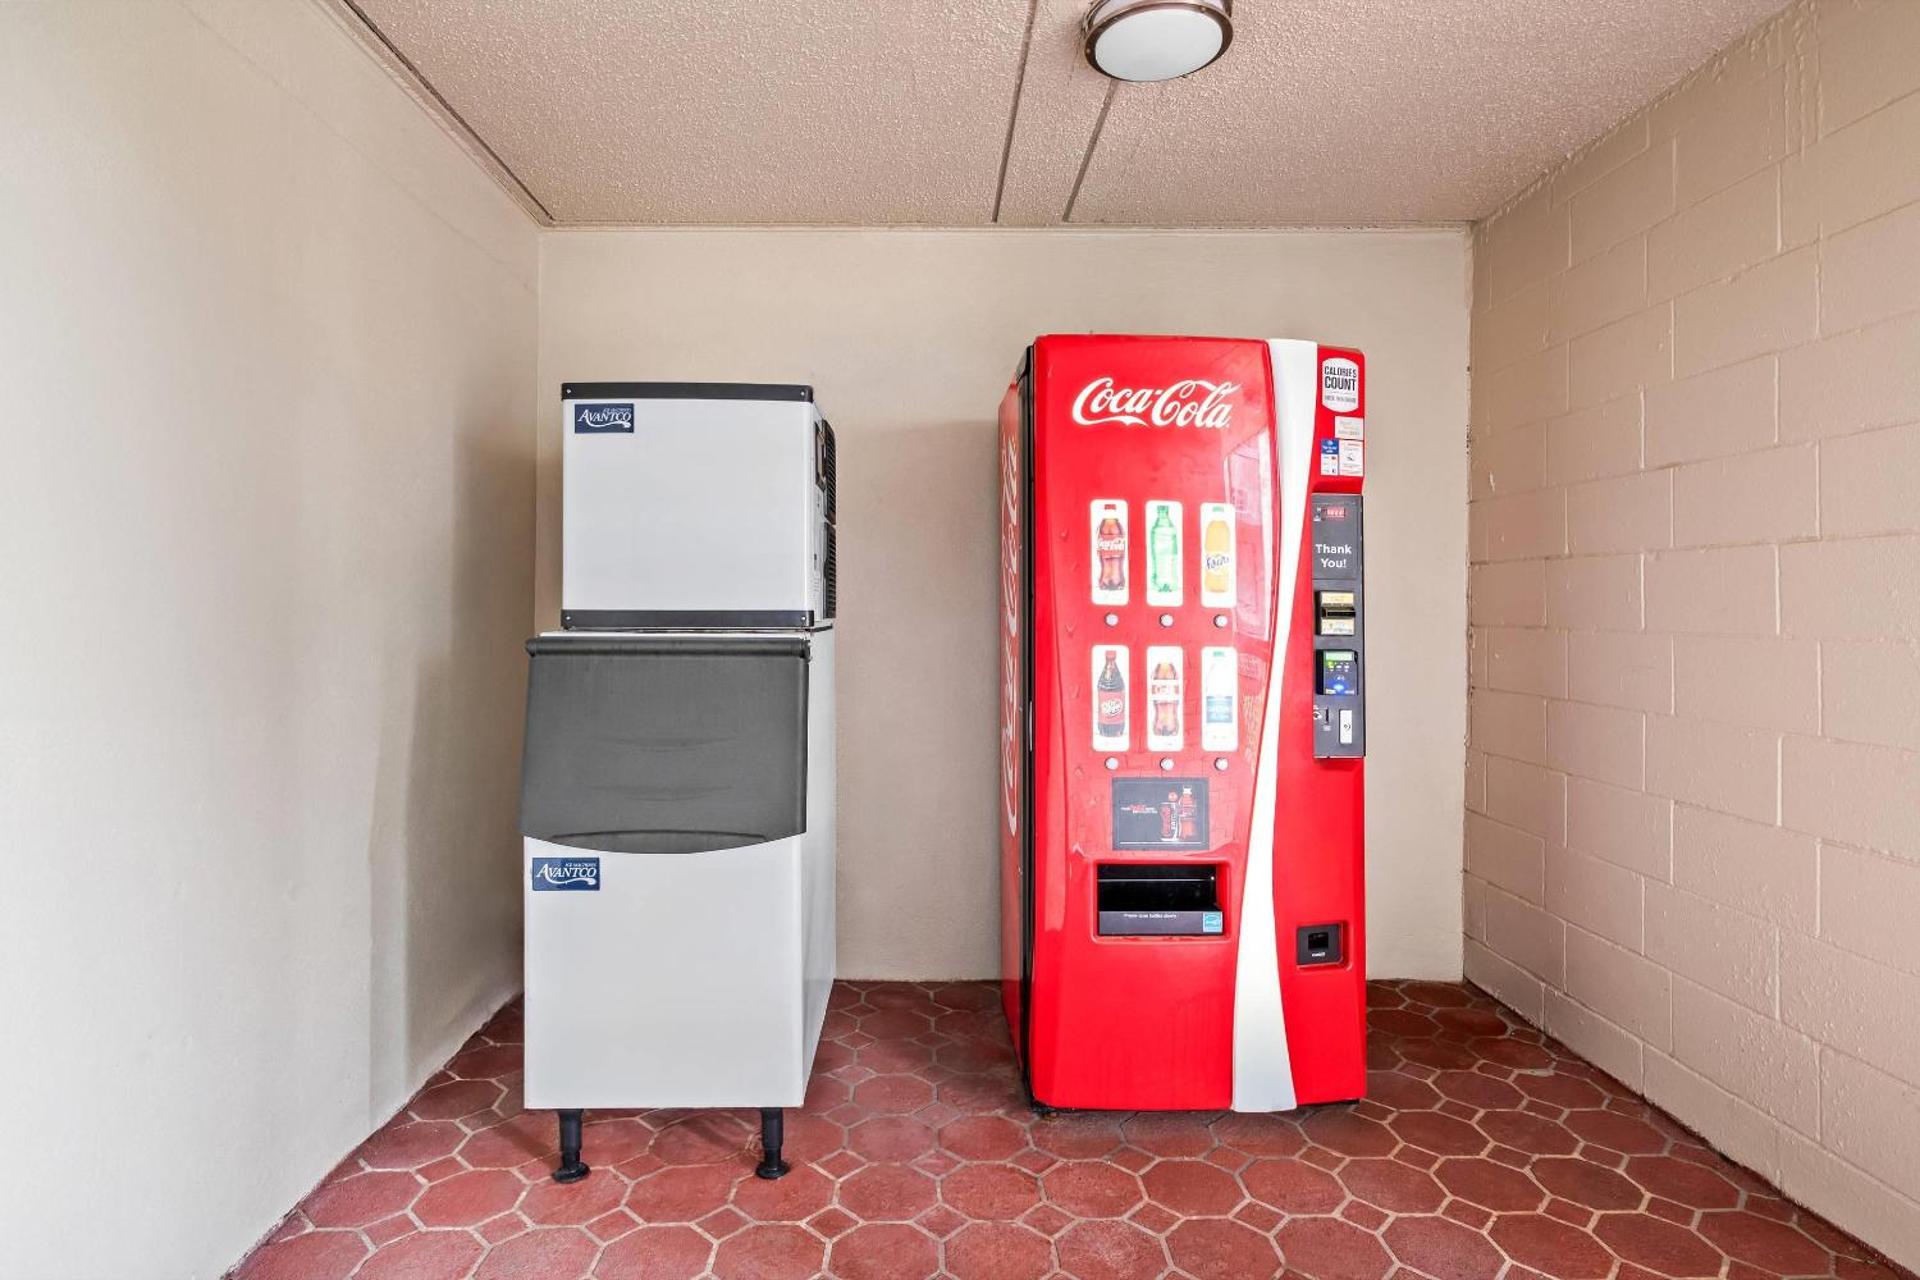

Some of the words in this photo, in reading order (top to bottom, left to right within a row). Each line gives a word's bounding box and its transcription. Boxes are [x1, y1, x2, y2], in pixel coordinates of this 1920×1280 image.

[1324, 366, 1357, 378] CALORIES
[1324, 376, 1357, 391] COUNT
[1071, 376, 1241, 429] Coca-Cola
[1315, 543, 1352, 554] Thank
[1320, 558, 1347, 568] You!
[1001, 433, 1017, 837] Coca-Cola
[535, 863, 597, 884] AVANTCO
